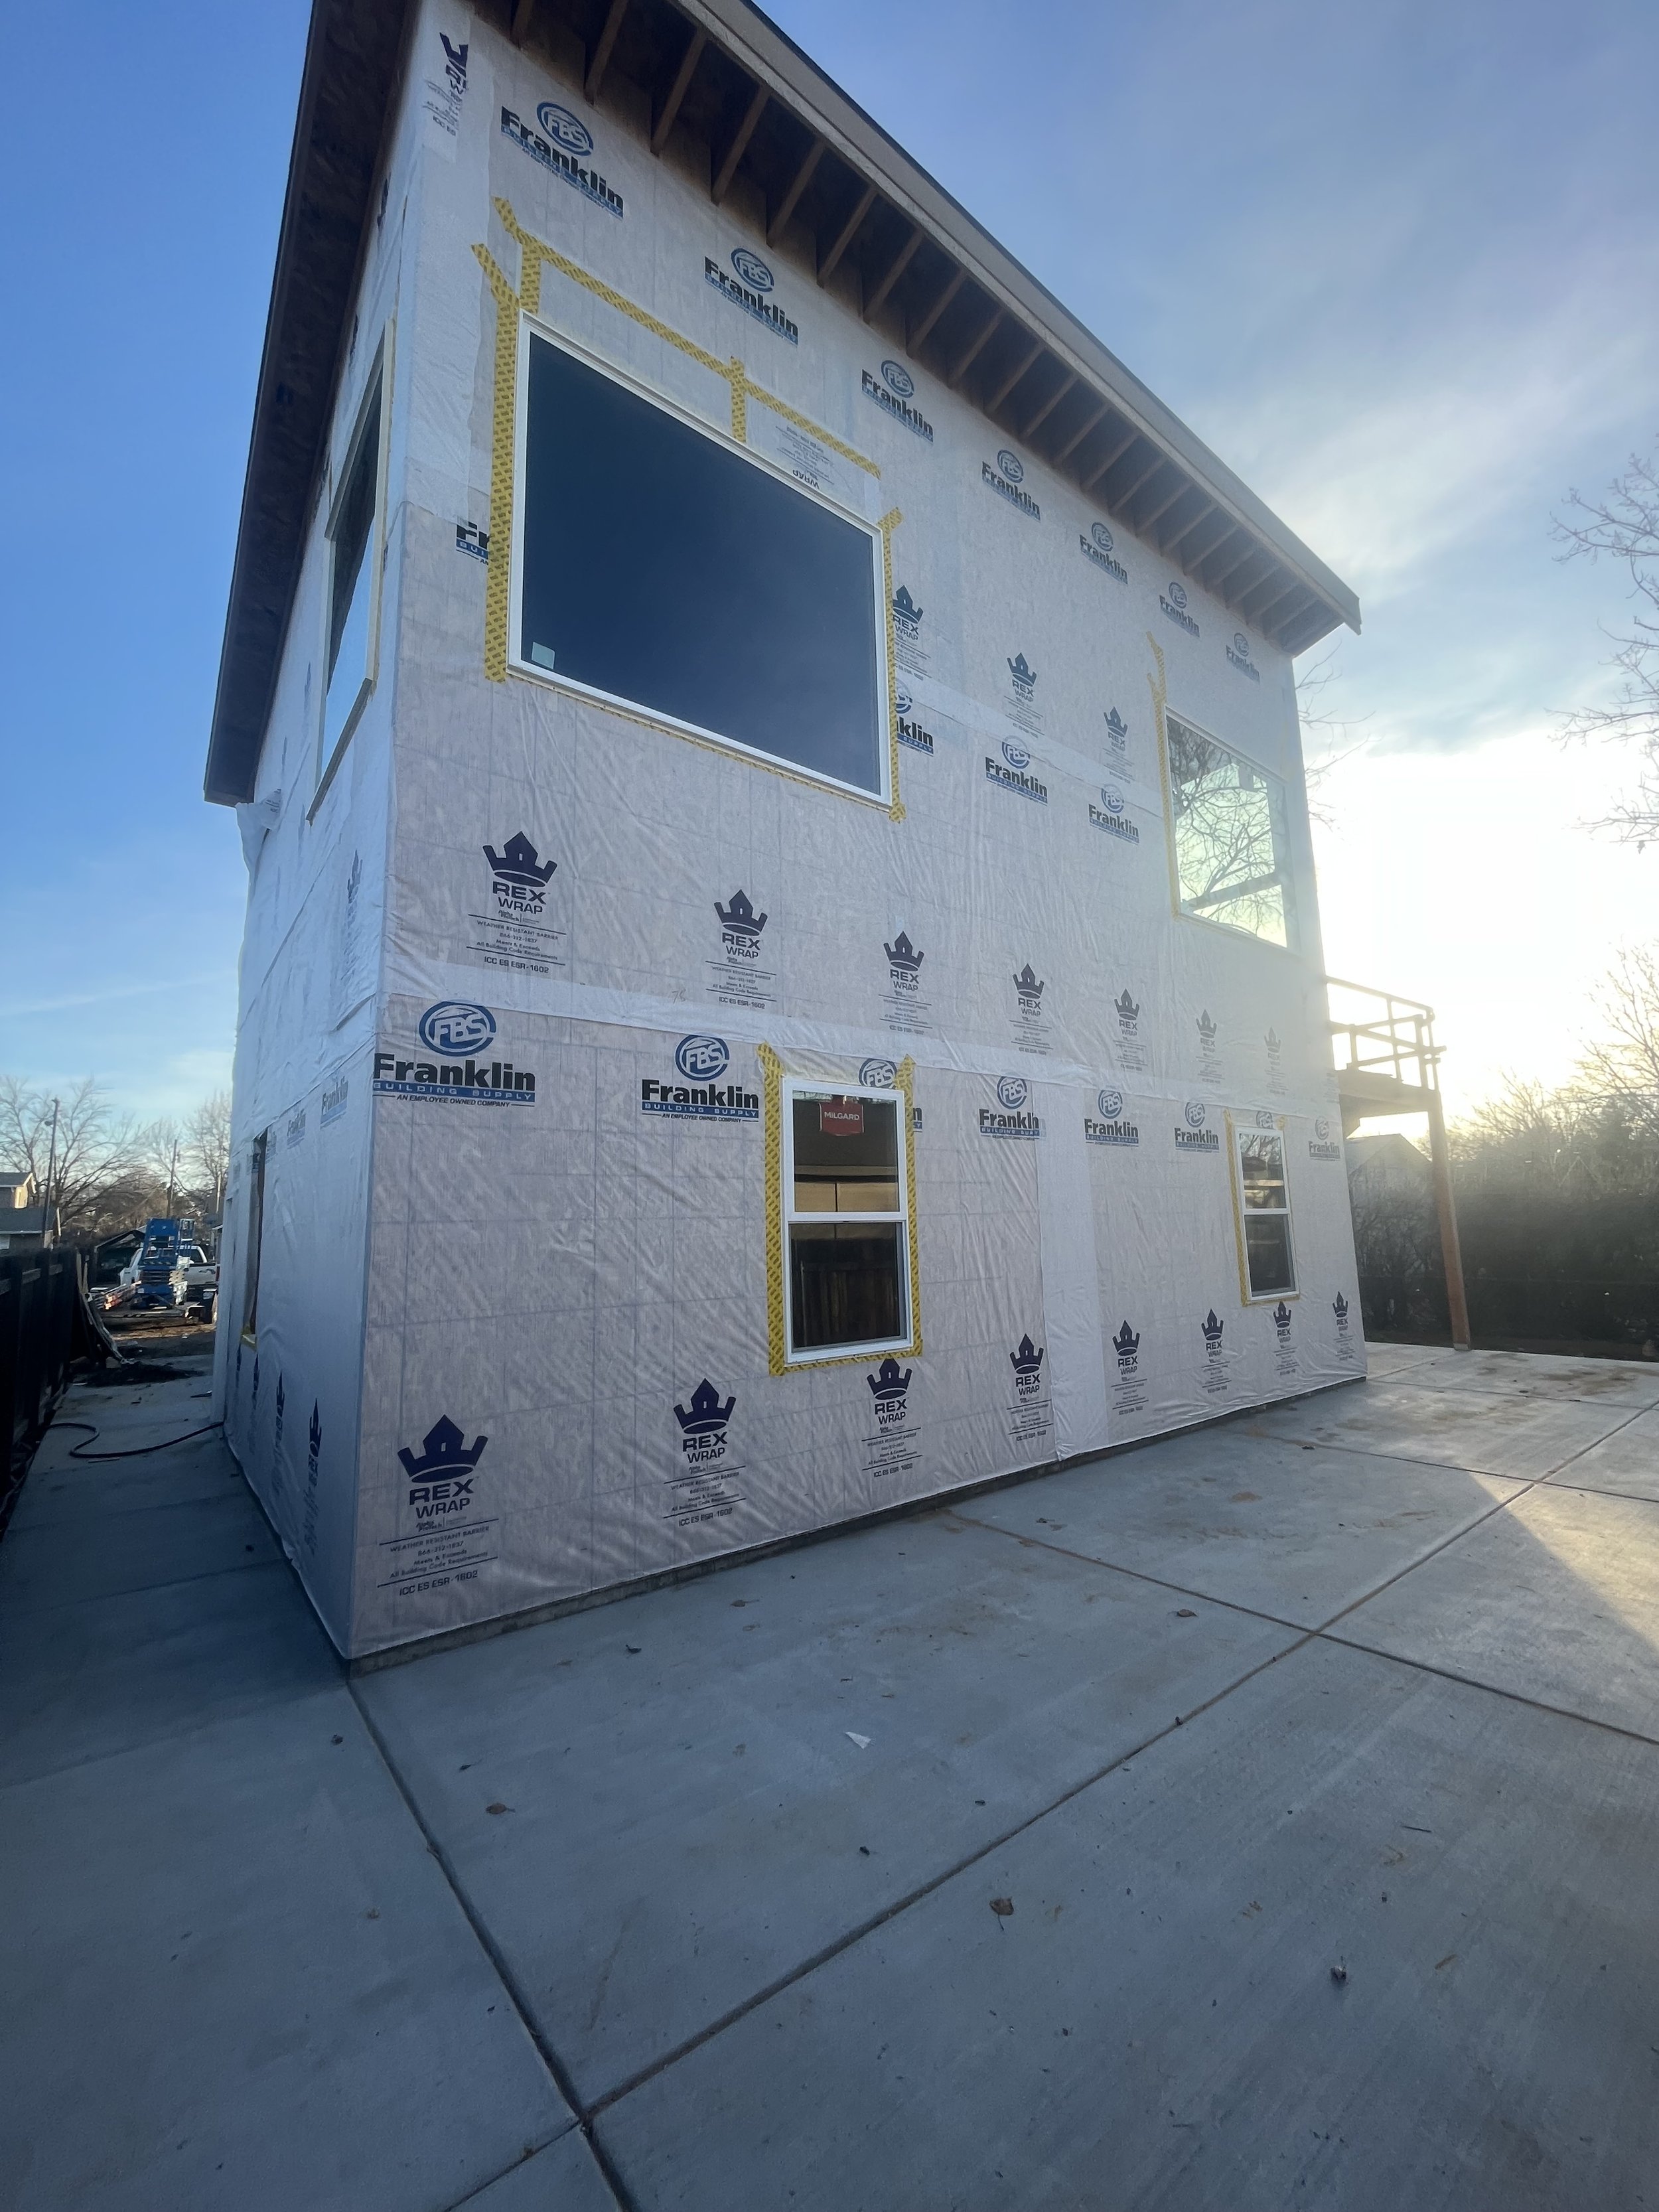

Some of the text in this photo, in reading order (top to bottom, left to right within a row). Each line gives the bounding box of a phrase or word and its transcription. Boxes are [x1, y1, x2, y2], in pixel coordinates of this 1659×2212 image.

[502, 106, 623, 212] Franklin
[705, 256, 798, 336] Franklin
[862, 369, 933, 436] Franklin
[982, 461, 1040, 515] Franklin
[1080, 534, 1127, 580] Franklin
[1159, 595, 1200, 634] Franklin
[893, 615, 919, 636] REX
[896, 625, 919, 640] WRAP
[1012, 679, 1034, 698] REX
[1108, 731, 1125, 747] REX
[985, 757, 1048, 797] Franklin
[1088, 804, 1139, 838] Franklin
[493, 881, 546, 905] REX
[498, 897, 543, 915] WRAP
[722, 932, 760, 950] REX
[484, 956, 497, 965] ICC
[726, 945, 758, 959] WRAP
[890, 968, 919, 984] REX
[893, 980, 918, 992] WRAP
[1018, 997, 1042, 1010] REX
[1021, 1007, 1041, 1017] WRAP
[1119, 1019, 1137, 1031] REX
[1200, 1037, 1215, 1047] REX
[373, 1053, 536, 1091] Franklin
[373, 1081, 532, 1100] BUILDING SUPPLY
[642, 1078, 759, 1109] Franklin
[409, 1095, 448, 1104] EMPLOYEE
[450, 1097, 476, 1106] OWNED
[644, 1102, 757, 1116] BUILDING SUPPLY
[824, 1111, 860, 1121] MILGARD
[1084, 1118, 1139, 1138] Franklin
[1175, 1127, 1219, 1144] Franklin
[1308, 1140, 1339, 1155] Franklin
[1277, 1329, 1291, 1337] REX
[1206, 1340, 1222, 1351] REX
[1118, 1355, 1139, 1368] REX
[1119, 1365, 1137, 1376] WRAP
[1015, 1373, 1041, 1387] REX
[1019, 1384, 1040, 1396] WRAP
[874, 1398, 908, 1415] REX
[878, 1412, 906, 1425] WRAP
[682, 1431, 728, 1452] REX
[687, 1447, 725, 1464] WRAP
[409, 1478, 474, 1506] REX
[415, 1497, 470, 1519] WRAP
[678, 1518, 690, 1526] ICC
[691, 1515, 699, 1524] ES
[390, 1526, 490, 1552] WEATHER RESISTANT BARRIER
[399, 1585, 415, 1596] ICC
[417, 1582, 429, 1592] ES
